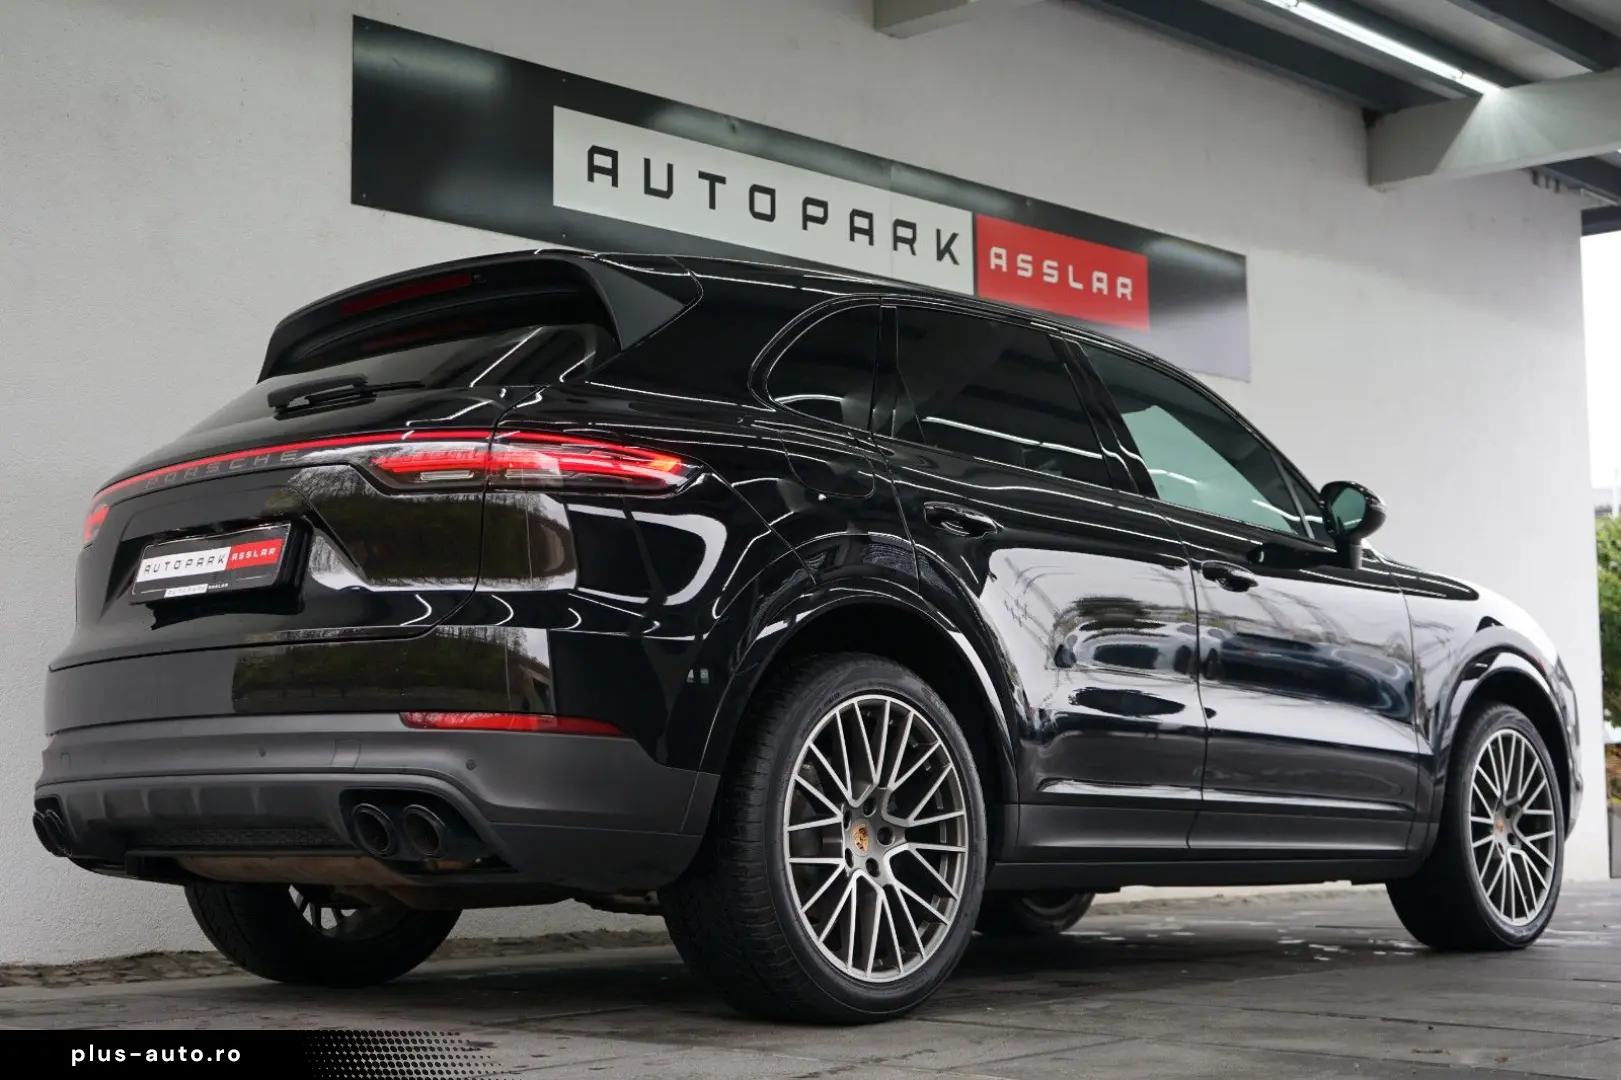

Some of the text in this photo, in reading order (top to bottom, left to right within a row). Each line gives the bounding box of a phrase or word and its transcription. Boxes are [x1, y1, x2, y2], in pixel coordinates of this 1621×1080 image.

[587, 144, 1134, 301] AUTOPARK ASSLAR
[144, 450, 299, 489] PORSCHE
[144, 547, 277, 574] AUTOPARK ASSLAR
